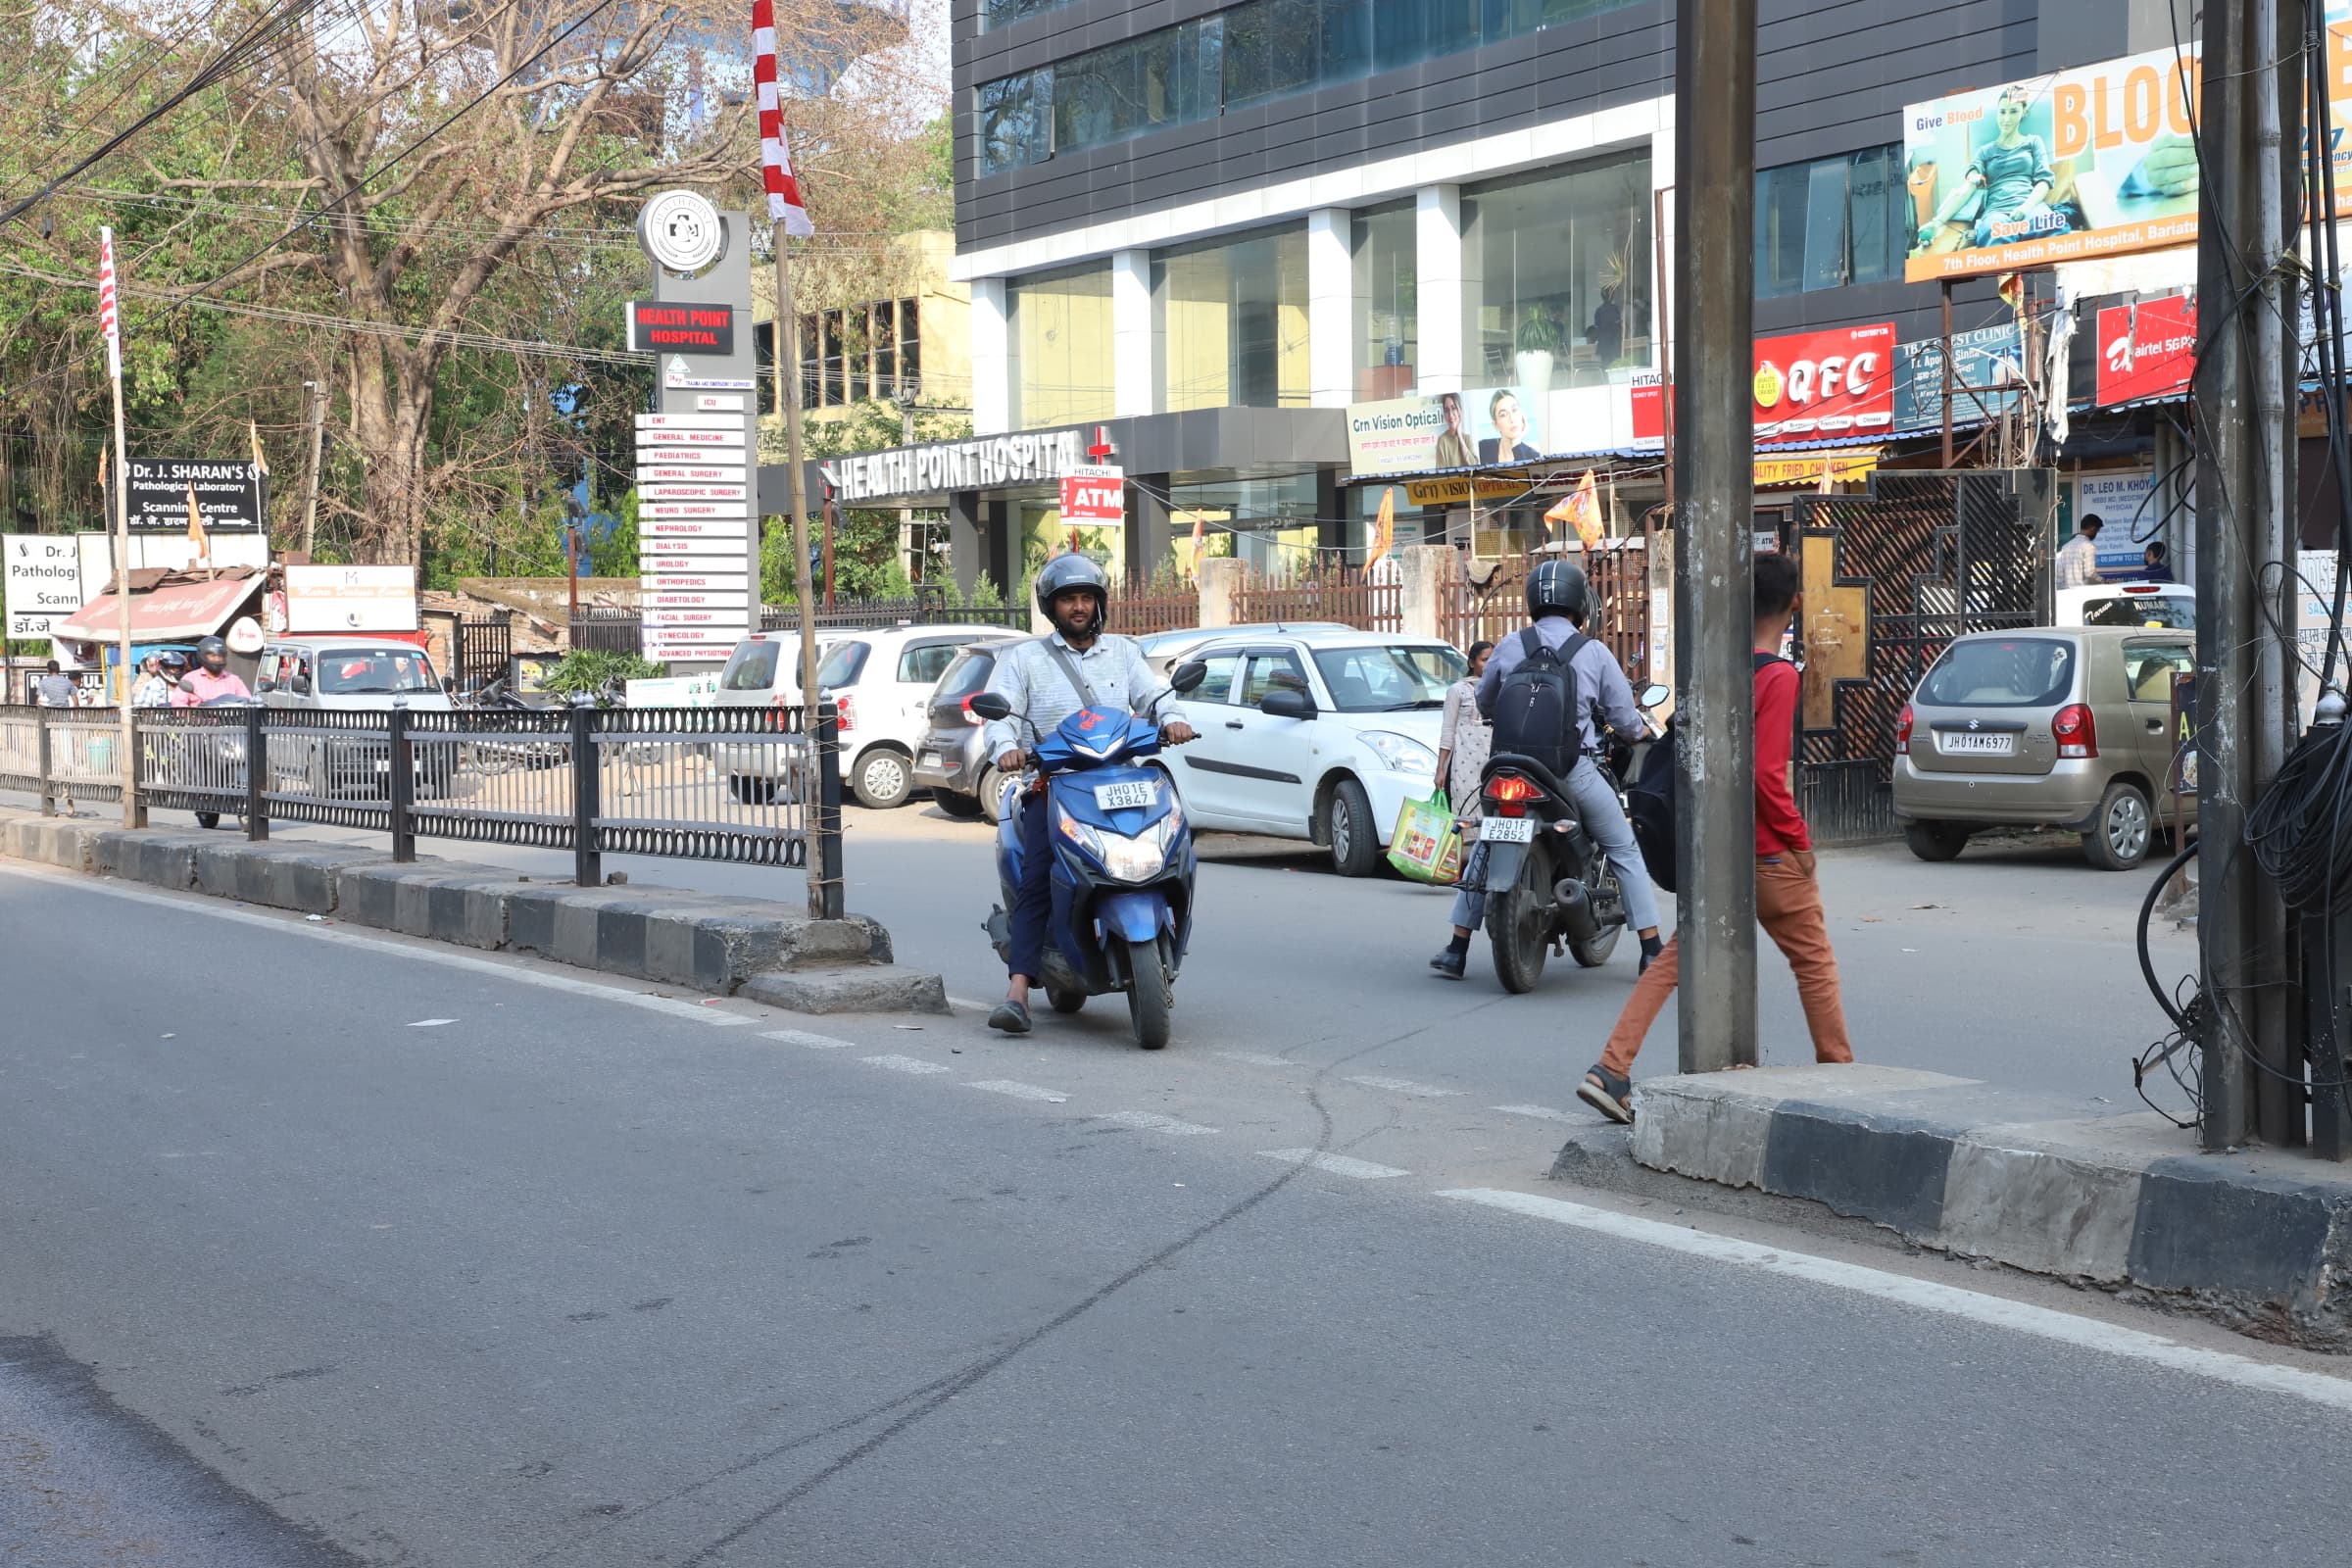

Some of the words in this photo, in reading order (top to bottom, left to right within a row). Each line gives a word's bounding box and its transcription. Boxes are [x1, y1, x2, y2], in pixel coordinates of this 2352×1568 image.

[1916, 117, 1942, 131] Give
[1947, 106, 1983, 124] Blood
[1991, 220, 2030, 237] Save
[2034, 214, 2065, 230] Life
[1944, 258, 1963, 271] 7th
[1967, 254, 2000, 268] Floor,
[2003, 246, 2044, 263] Health
[2048, 240, 2081, 259] Point
[2084, 230, 2143, 251] Hospital,
[637, 308, 686, 325] HEALTH
[690, 310, 729, 327] POINT
[650, 329, 718, 345] HOSPITAL
[1974, 325, 2014, 342] CLINIC
[2134, 341, 2163, 357] airtel
[1788, 352, 1879, 404] QFC
[1353, 418, 1370, 432] Grn
[1371, 414, 1402, 430] Vision
[133, 465, 153, 478] Dr.
[157, 465, 168, 478] J.
[172, 465, 244, 479] SHARAN'S
[840, 448, 915, 501] HEALTH
[915, 444, 978, 490] POINT
[1782, 464, 1804, 477] FRIED
[132, 481, 190, 493] Pathologica
[193, 482, 245, 494] Laboratory
[2083, 483, 2096, 495] DR.
[2098, 482, 2115, 494] LEO
[1074, 488, 1121, 508] ATM
[142, 502, 190, 514] Scannin
[199, 502, 238, 514] Centre
[46, 546, 66, 558] Dr.
[37, 592, 78, 605] Scann
[1948, 737, 2010, 750] JH01AM6977
[1106, 783, 1148, 797] JH01E
[1108, 794, 1148, 807] X3847
[1491, 819, 1528, 831] JH01F
[1489, 829, 1525, 840] E2852
